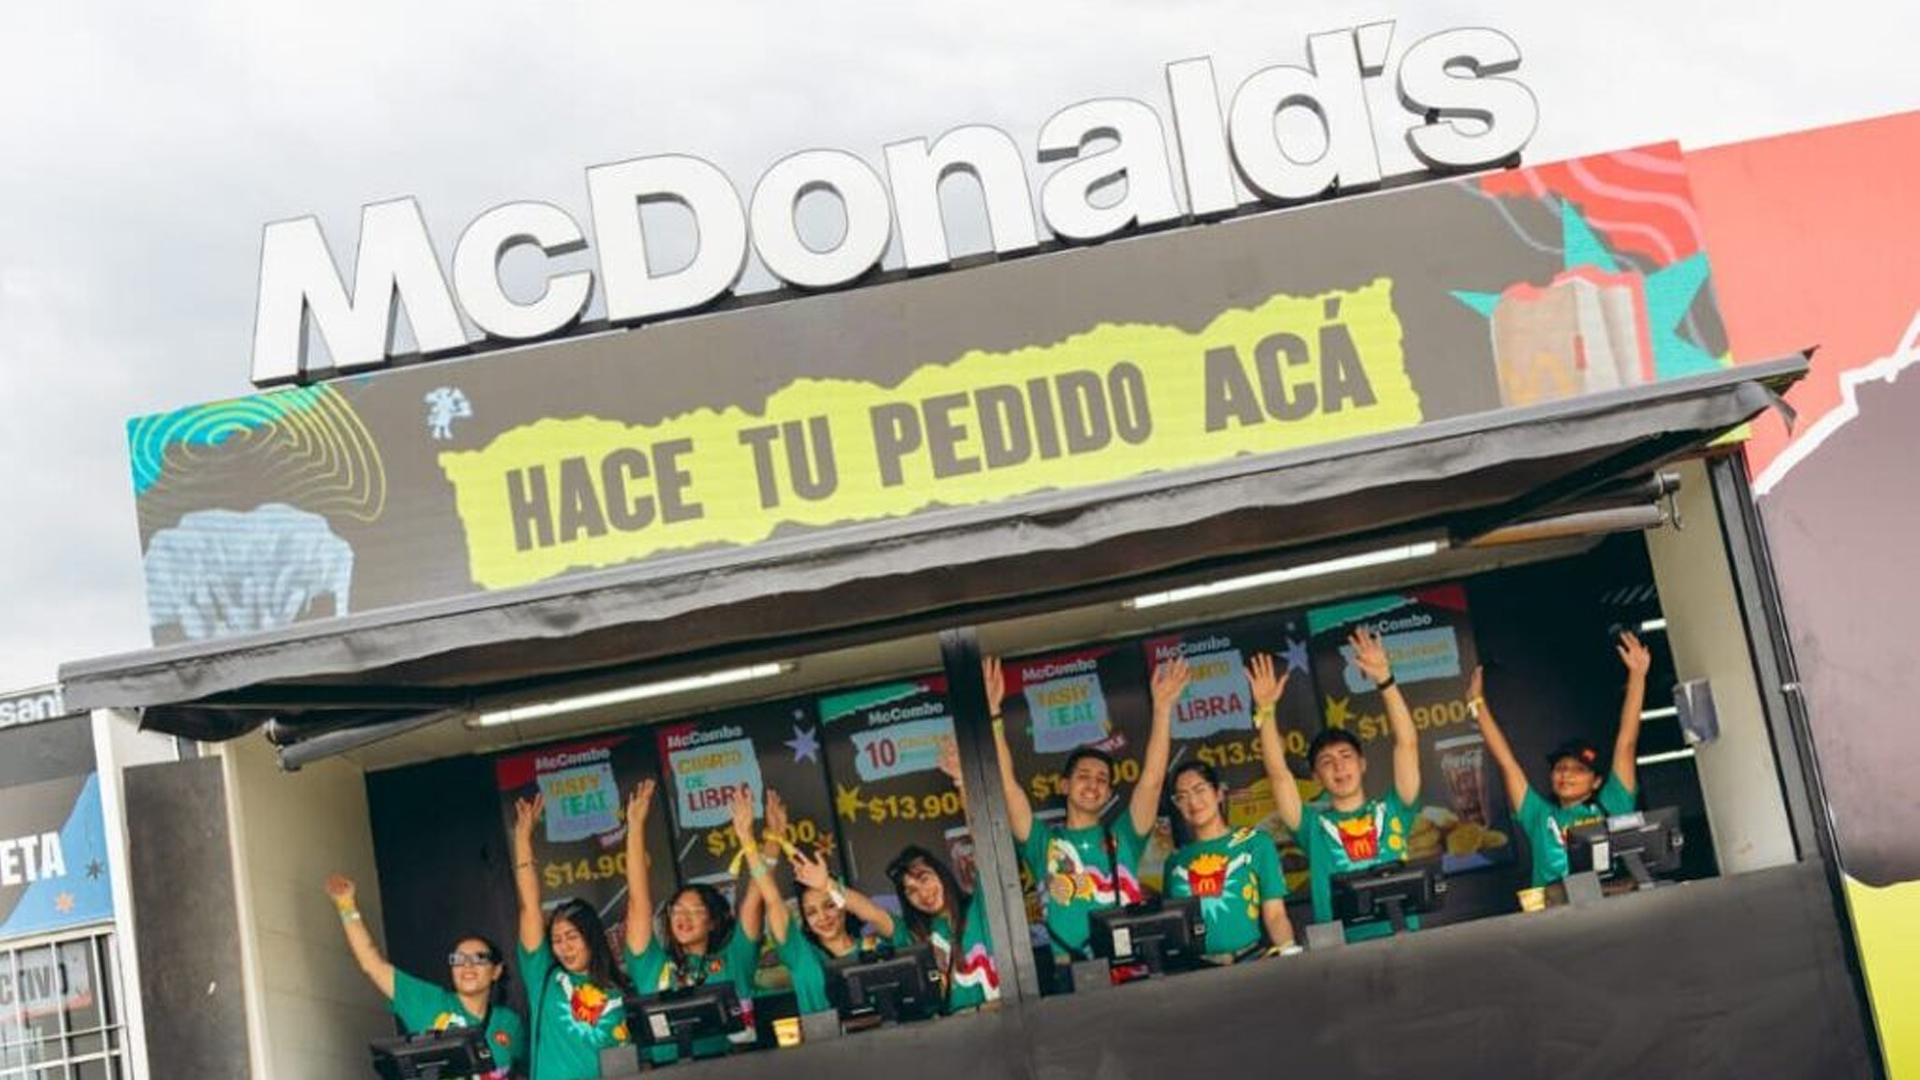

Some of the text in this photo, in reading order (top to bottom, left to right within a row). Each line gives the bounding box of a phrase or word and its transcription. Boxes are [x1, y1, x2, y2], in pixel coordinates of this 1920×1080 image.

[250, 20, 1540, 388] McDonald's
[505, 296, 1379, 553] HACE TU PEDIDO ACÁ
[1155, 634, 1232, 659] McCombo
[1021, 658, 1098, 682] McCombo
[867, 701, 944, 726] McCombo
[1176, 692, 1244, 724] LIBRA
[1357, 700, 1466, 742] $1900
[666, 724, 744, 749] McCombo
[1197, 730, 1307, 768] $13.90
[534, 747, 611, 770] McCombo
[864, 737, 898, 770] 10
[868, 791, 963, 824] $13.90
[705, 818, 816, 858] $100
[0, 831, 67, 887] ETA
[544, 851, 651, 889] $14.90
